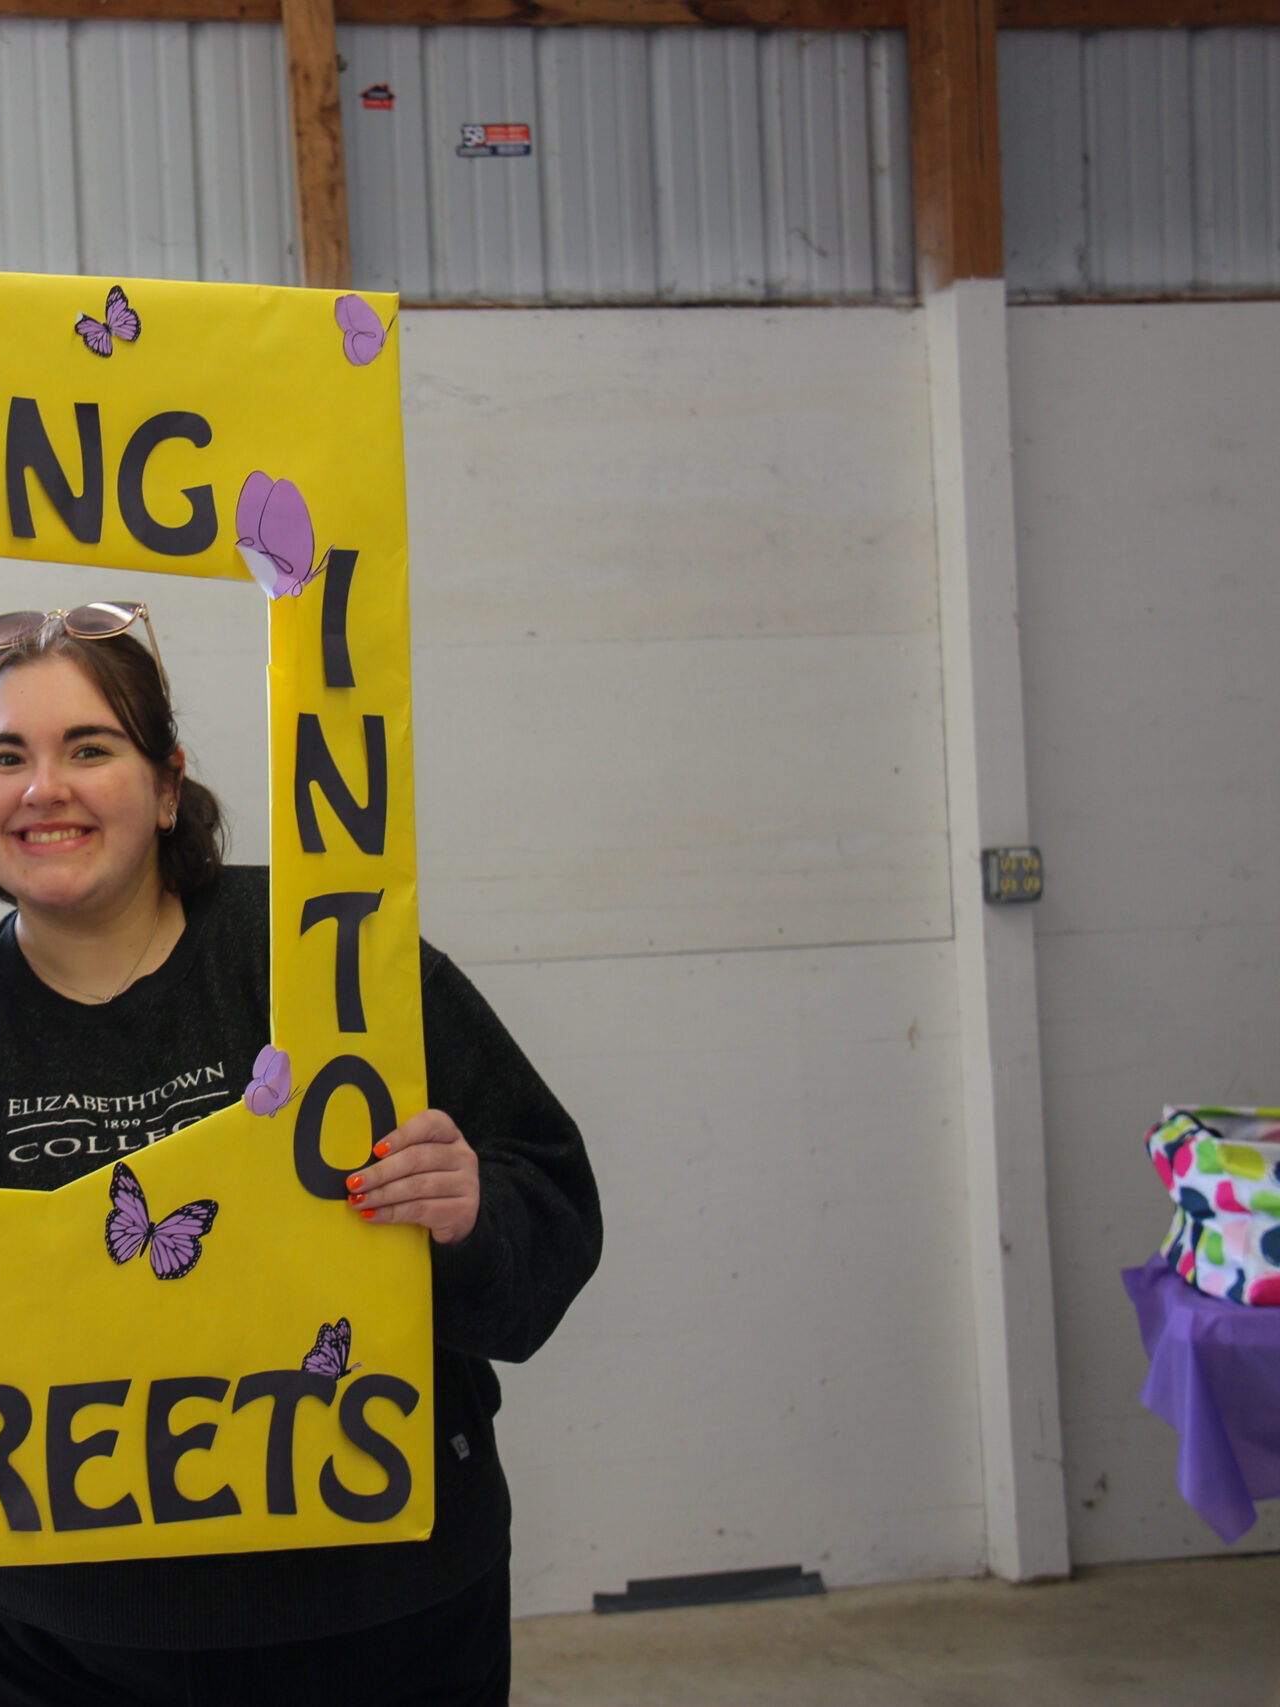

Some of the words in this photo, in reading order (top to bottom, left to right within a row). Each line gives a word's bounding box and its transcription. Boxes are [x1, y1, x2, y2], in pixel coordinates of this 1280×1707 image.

[294, 549, 397, 1200] INTO
[7, 1062, 225, 1117] ELIZABETHTOWN
[8, 1111, 217, 1163] COLLE
[104, 1118, 141, 1129] 1899
